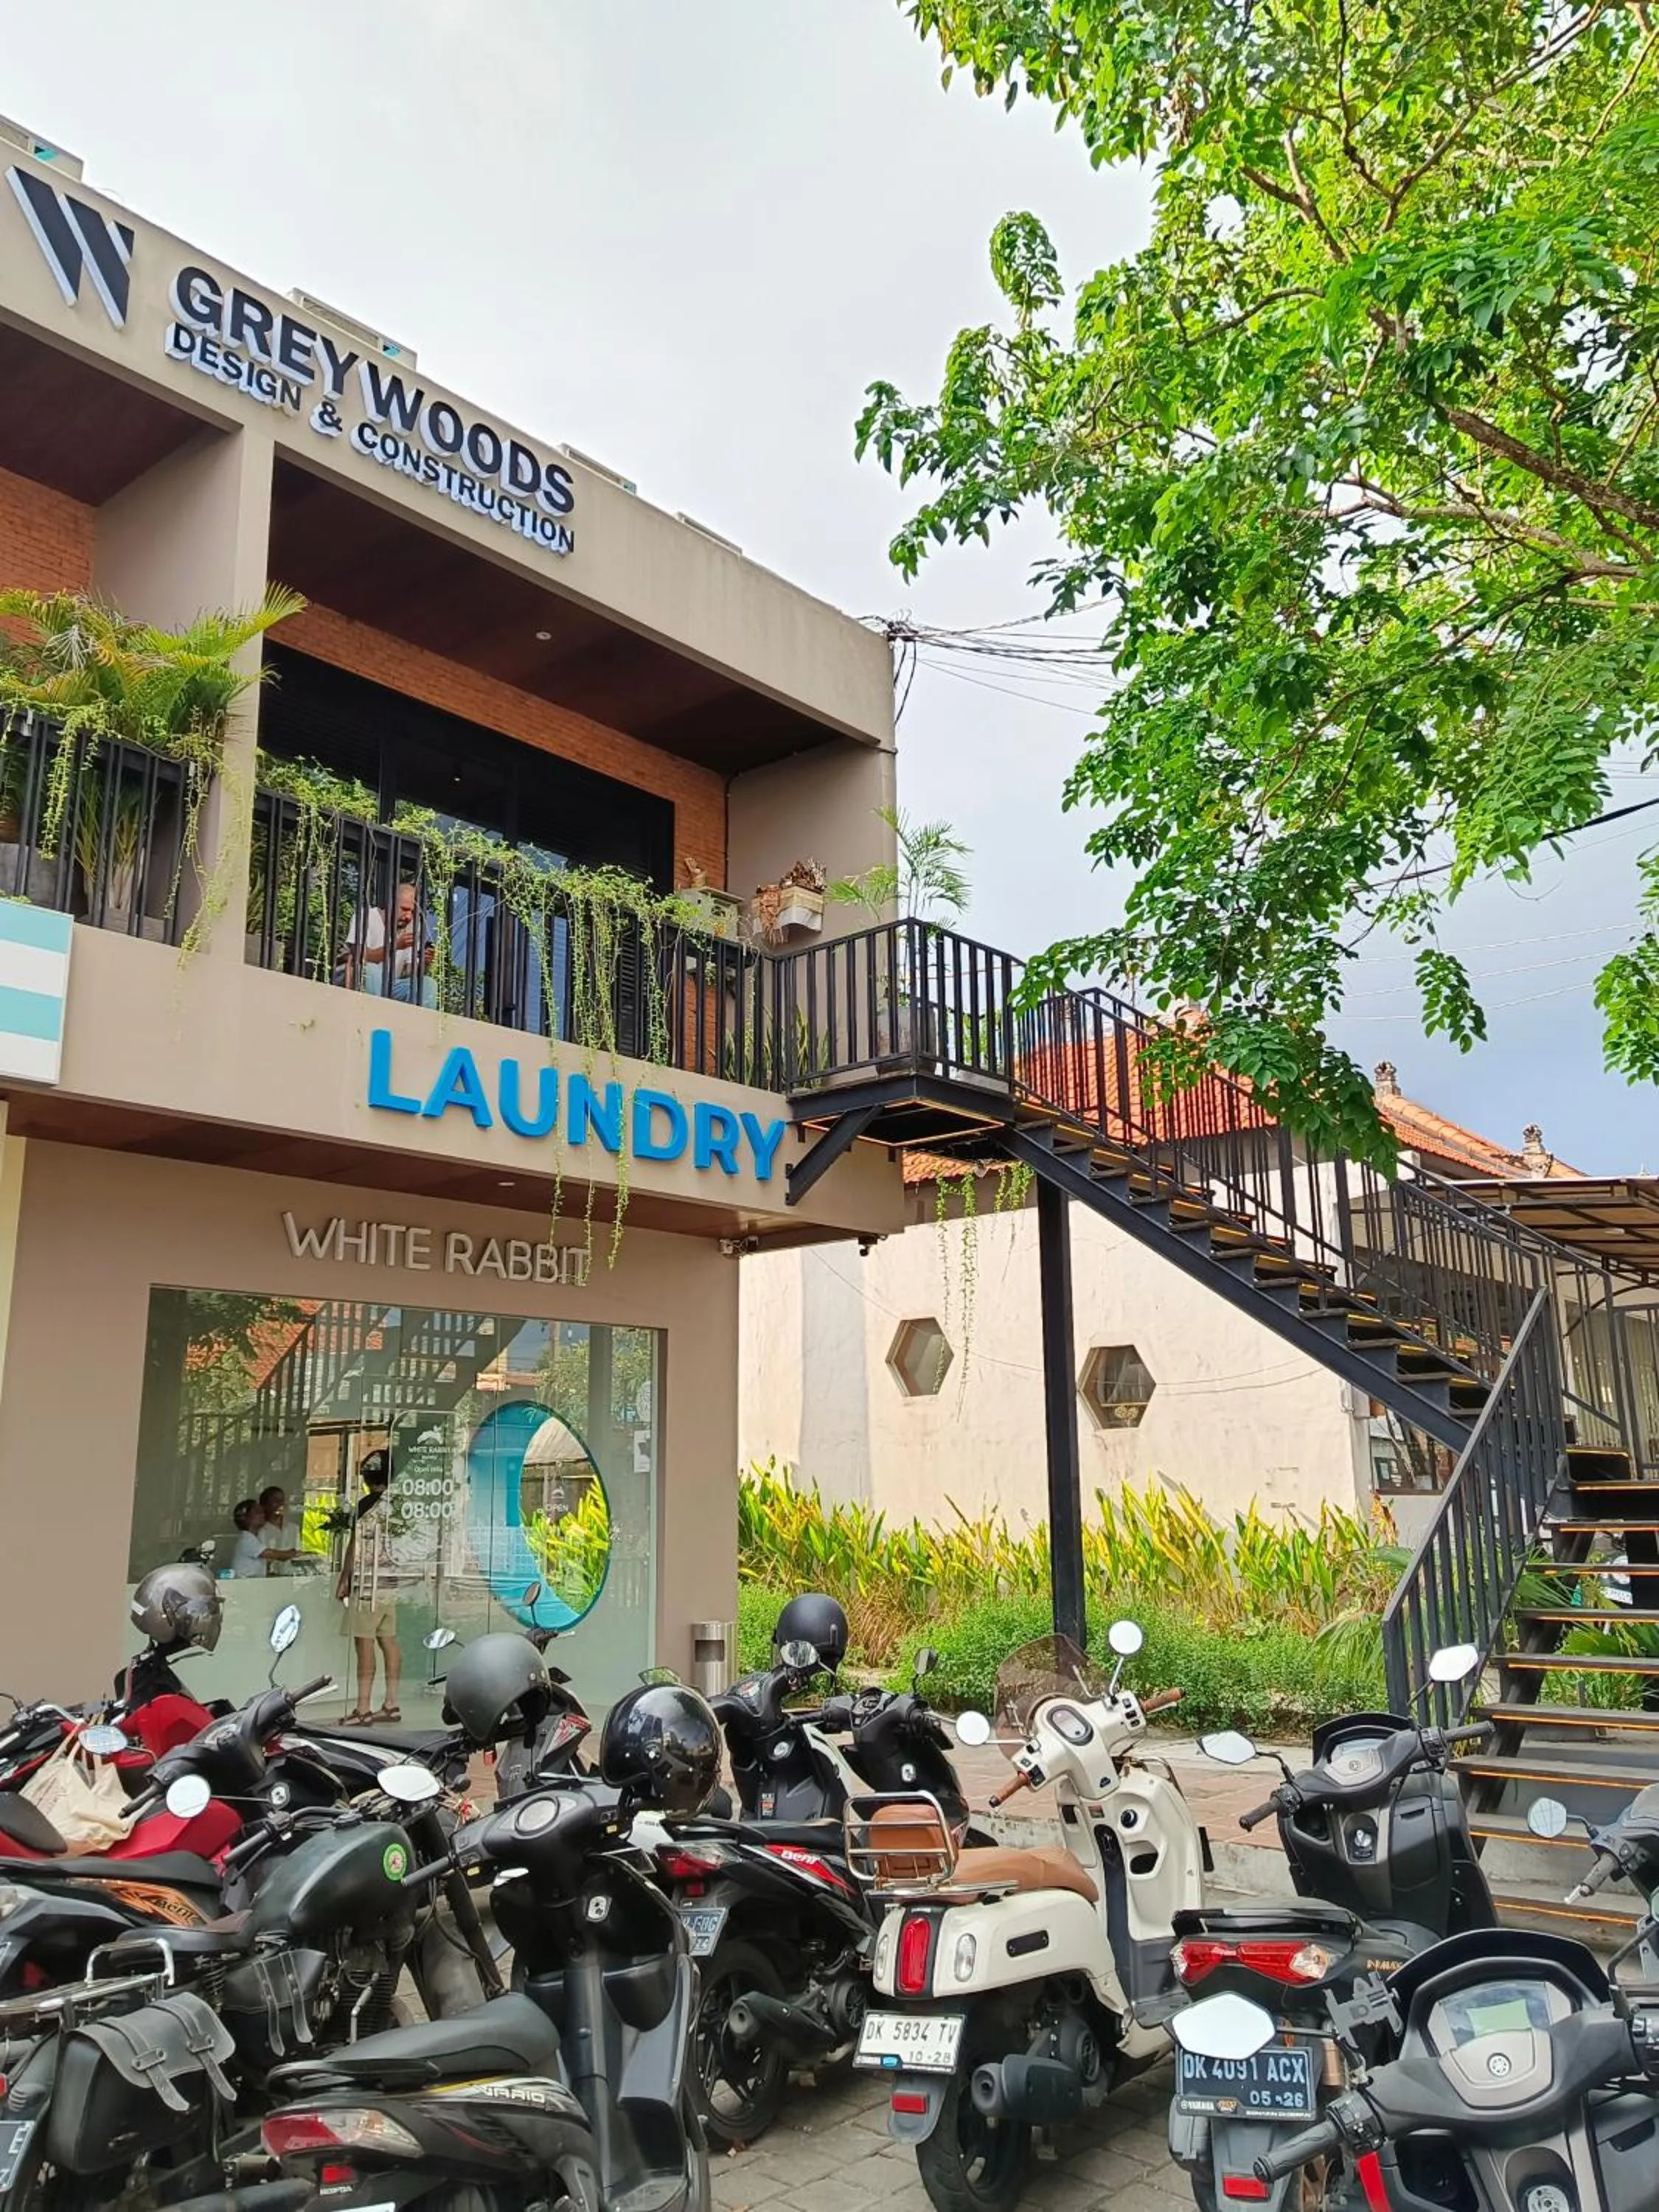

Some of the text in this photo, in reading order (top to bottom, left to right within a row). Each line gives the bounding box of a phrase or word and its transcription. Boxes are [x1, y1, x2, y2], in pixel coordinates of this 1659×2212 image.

[169, 265, 575, 518] GREYWOODS
[165, 321, 575, 557] DESIGN & CONSTRUCTION
[367, 1029, 786, 1180] LAUNDRY
[282, 1211, 591, 1287] WHITE RABBIT
[402, 1479, 453, 1496] 08:00
[400, 1502, 452, 1520] 08:00
[546, 1503, 568, 1512] OPEN
[866, 2020, 958, 2044] DK 5834 TV
[1183, 2053, 1305, 2084] DK 4091 ACX
